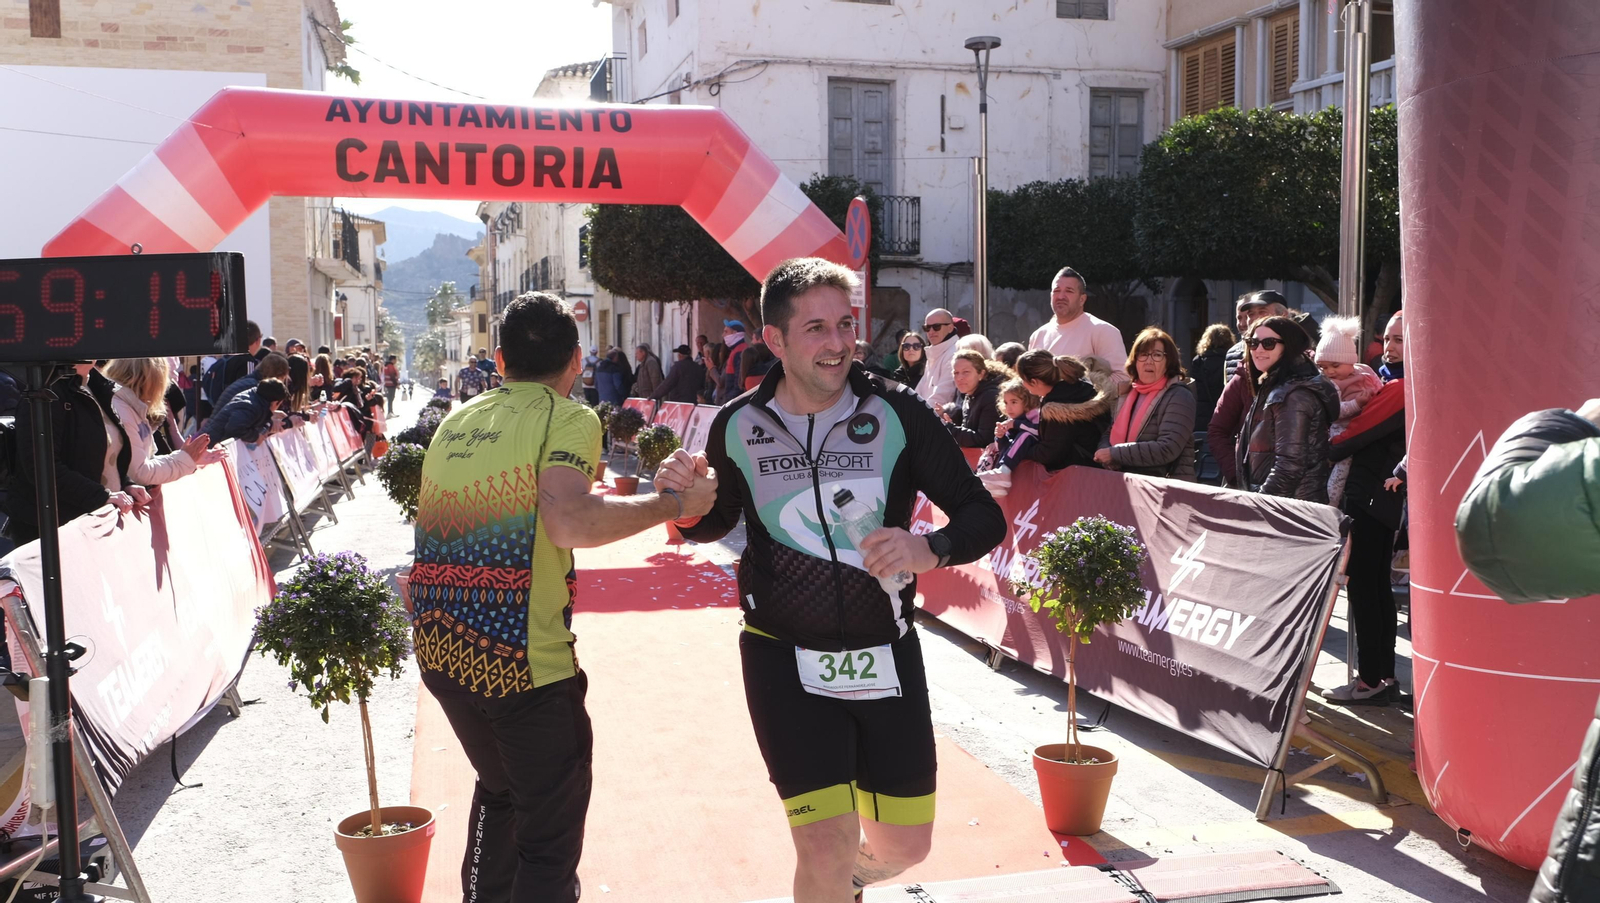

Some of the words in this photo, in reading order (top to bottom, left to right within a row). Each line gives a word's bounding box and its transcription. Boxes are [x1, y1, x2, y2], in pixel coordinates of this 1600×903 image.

[325, 98, 633, 133] AYUNTAMIENTO
[335, 137, 623, 190] CANTORIA
[746, 436, 776, 446] VIATOR
[783, 471, 806, 481] CLUB
[806, 471, 814, 479] &
[819, 470, 844, 479] SHOP
[818, 651, 878, 683] 342
[1117, 639, 1193, 678] www.teamergy.es
[473, 805, 486, 864] EVENTOS
[48, 889, 60, 899] 12
